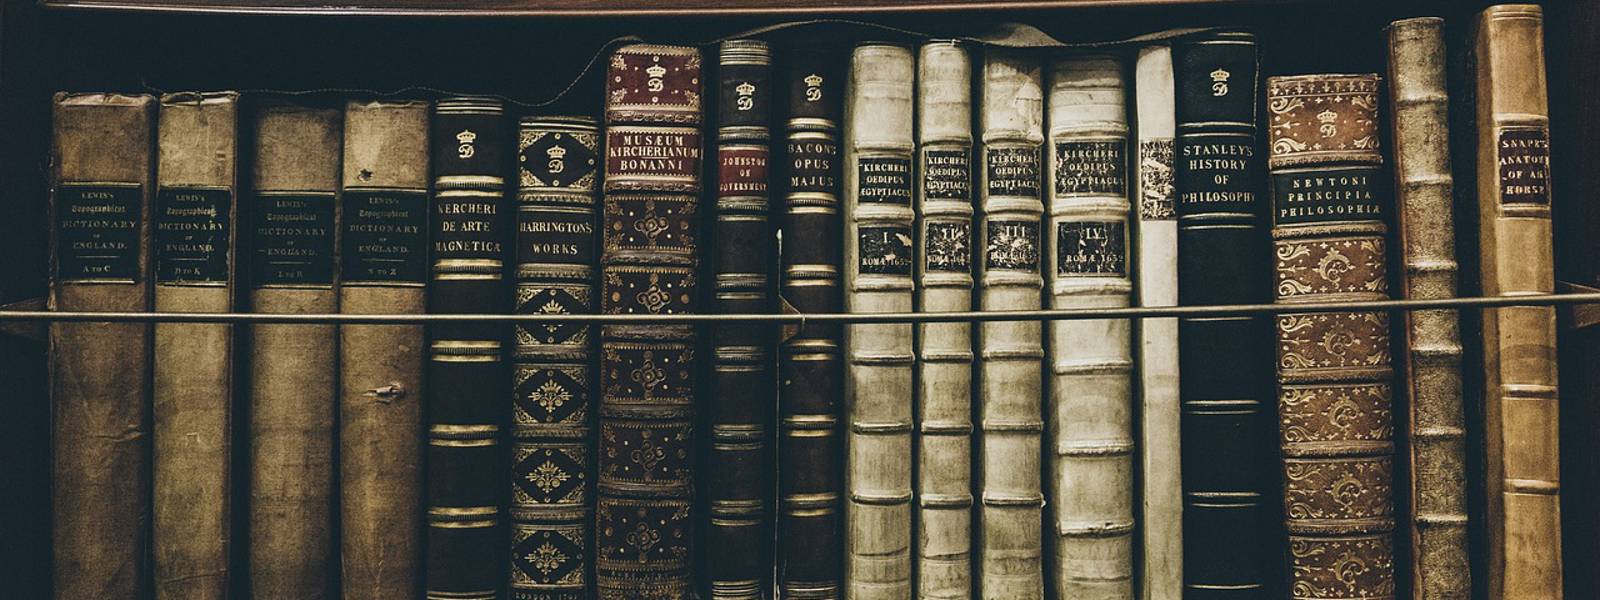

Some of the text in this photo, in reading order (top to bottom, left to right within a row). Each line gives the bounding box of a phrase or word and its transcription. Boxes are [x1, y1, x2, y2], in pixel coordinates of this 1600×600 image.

[610, 146, 699, 158] KIRCHERIANUM
[1064, 150, 1118, 158] KIRCHERI
[794, 159, 830, 169] OPUS
[928, 156, 968, 165] KIRCHERI
[992, 155, 1037, 164] KIRCHERI
[1189, 159, 1247, 170] HISTORY
[620, 159, 683, 171] BONANNI
[864, 164, 908, 172] KIRCHERI
[1069, 162, 1116, 171] OEDIPUS
[995, 166, 1034, 176] OEDIPUS
[1508, 170, 1523, 179] OF
[791, 176, 833, 187] MAJUS
[866, 175, 905, 184] OEDIPUS
[1214, 174, 1230, 185] OF
[1292, 176, 1368, 188] NEWTONI
[720, 182, 768, 192] GOVERNMENT
[1181, 192, 1256, 204] PHILOSOPHY
[1288, 190, 1372, 202] PRINCIPIA
[62, 220, 136, 228] DICTIONARY
[158, 222, 224, 231] DICTIONARY
[350, 224, 419, 233] DICTIONARY
[442, 221, 490, 232] DE ARTE
[258, 228, 326, 236] DICTIONARY
[532, 244, 578, 255] WORKS
